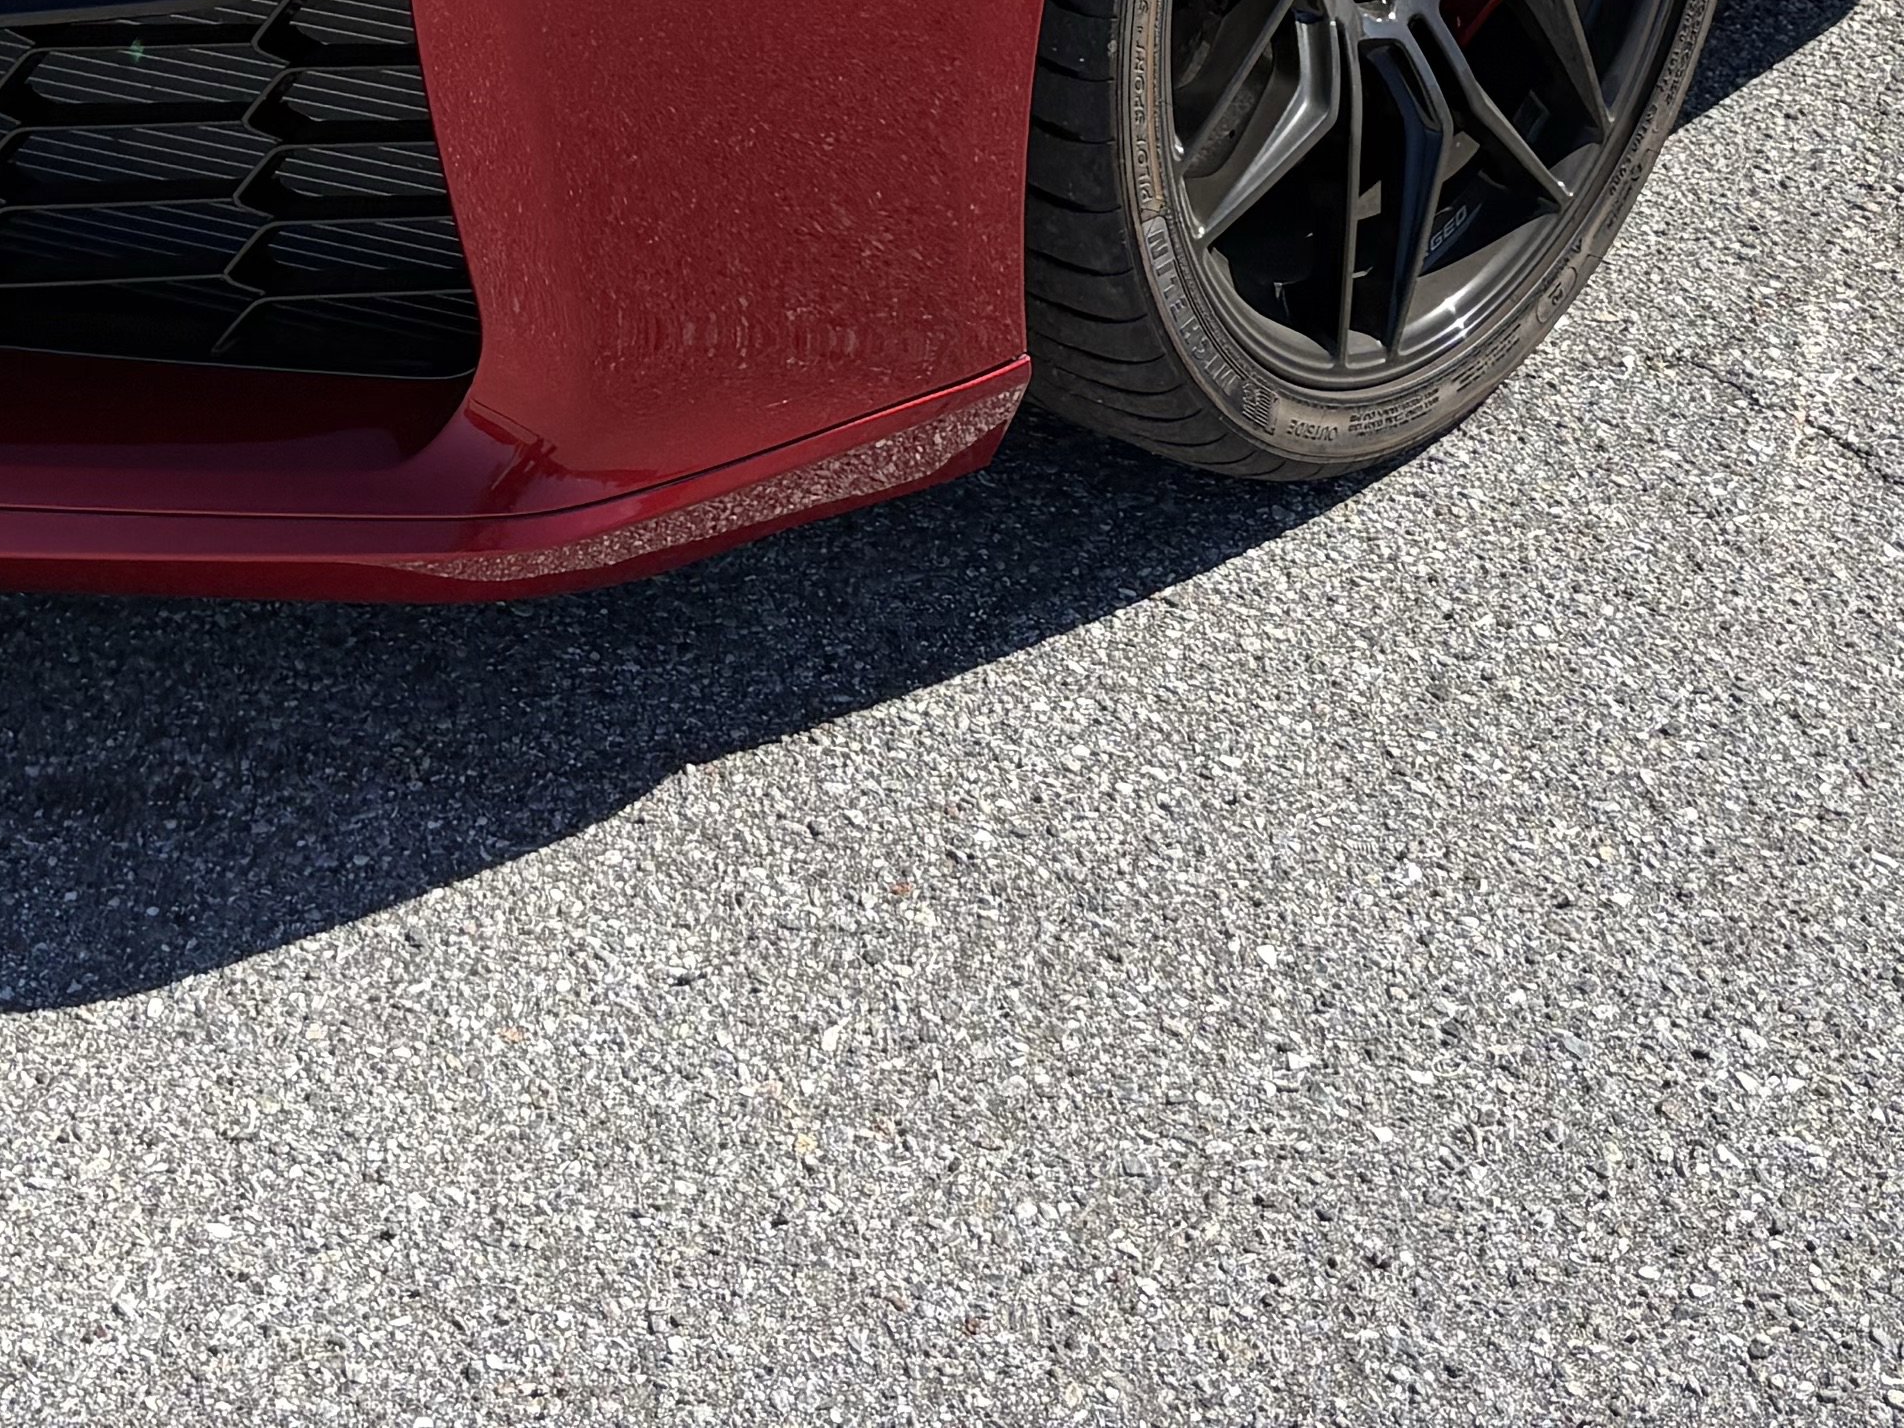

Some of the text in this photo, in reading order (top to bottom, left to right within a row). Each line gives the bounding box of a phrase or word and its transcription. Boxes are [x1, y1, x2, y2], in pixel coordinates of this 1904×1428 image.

[1133, 40, 1147, 126] SPORT
[1136, 139, 1153, 204] PILOT
[1147, 227, 1240, 396] MICHELIN
[1287, 418, 1339, 442] OUTSIDE
